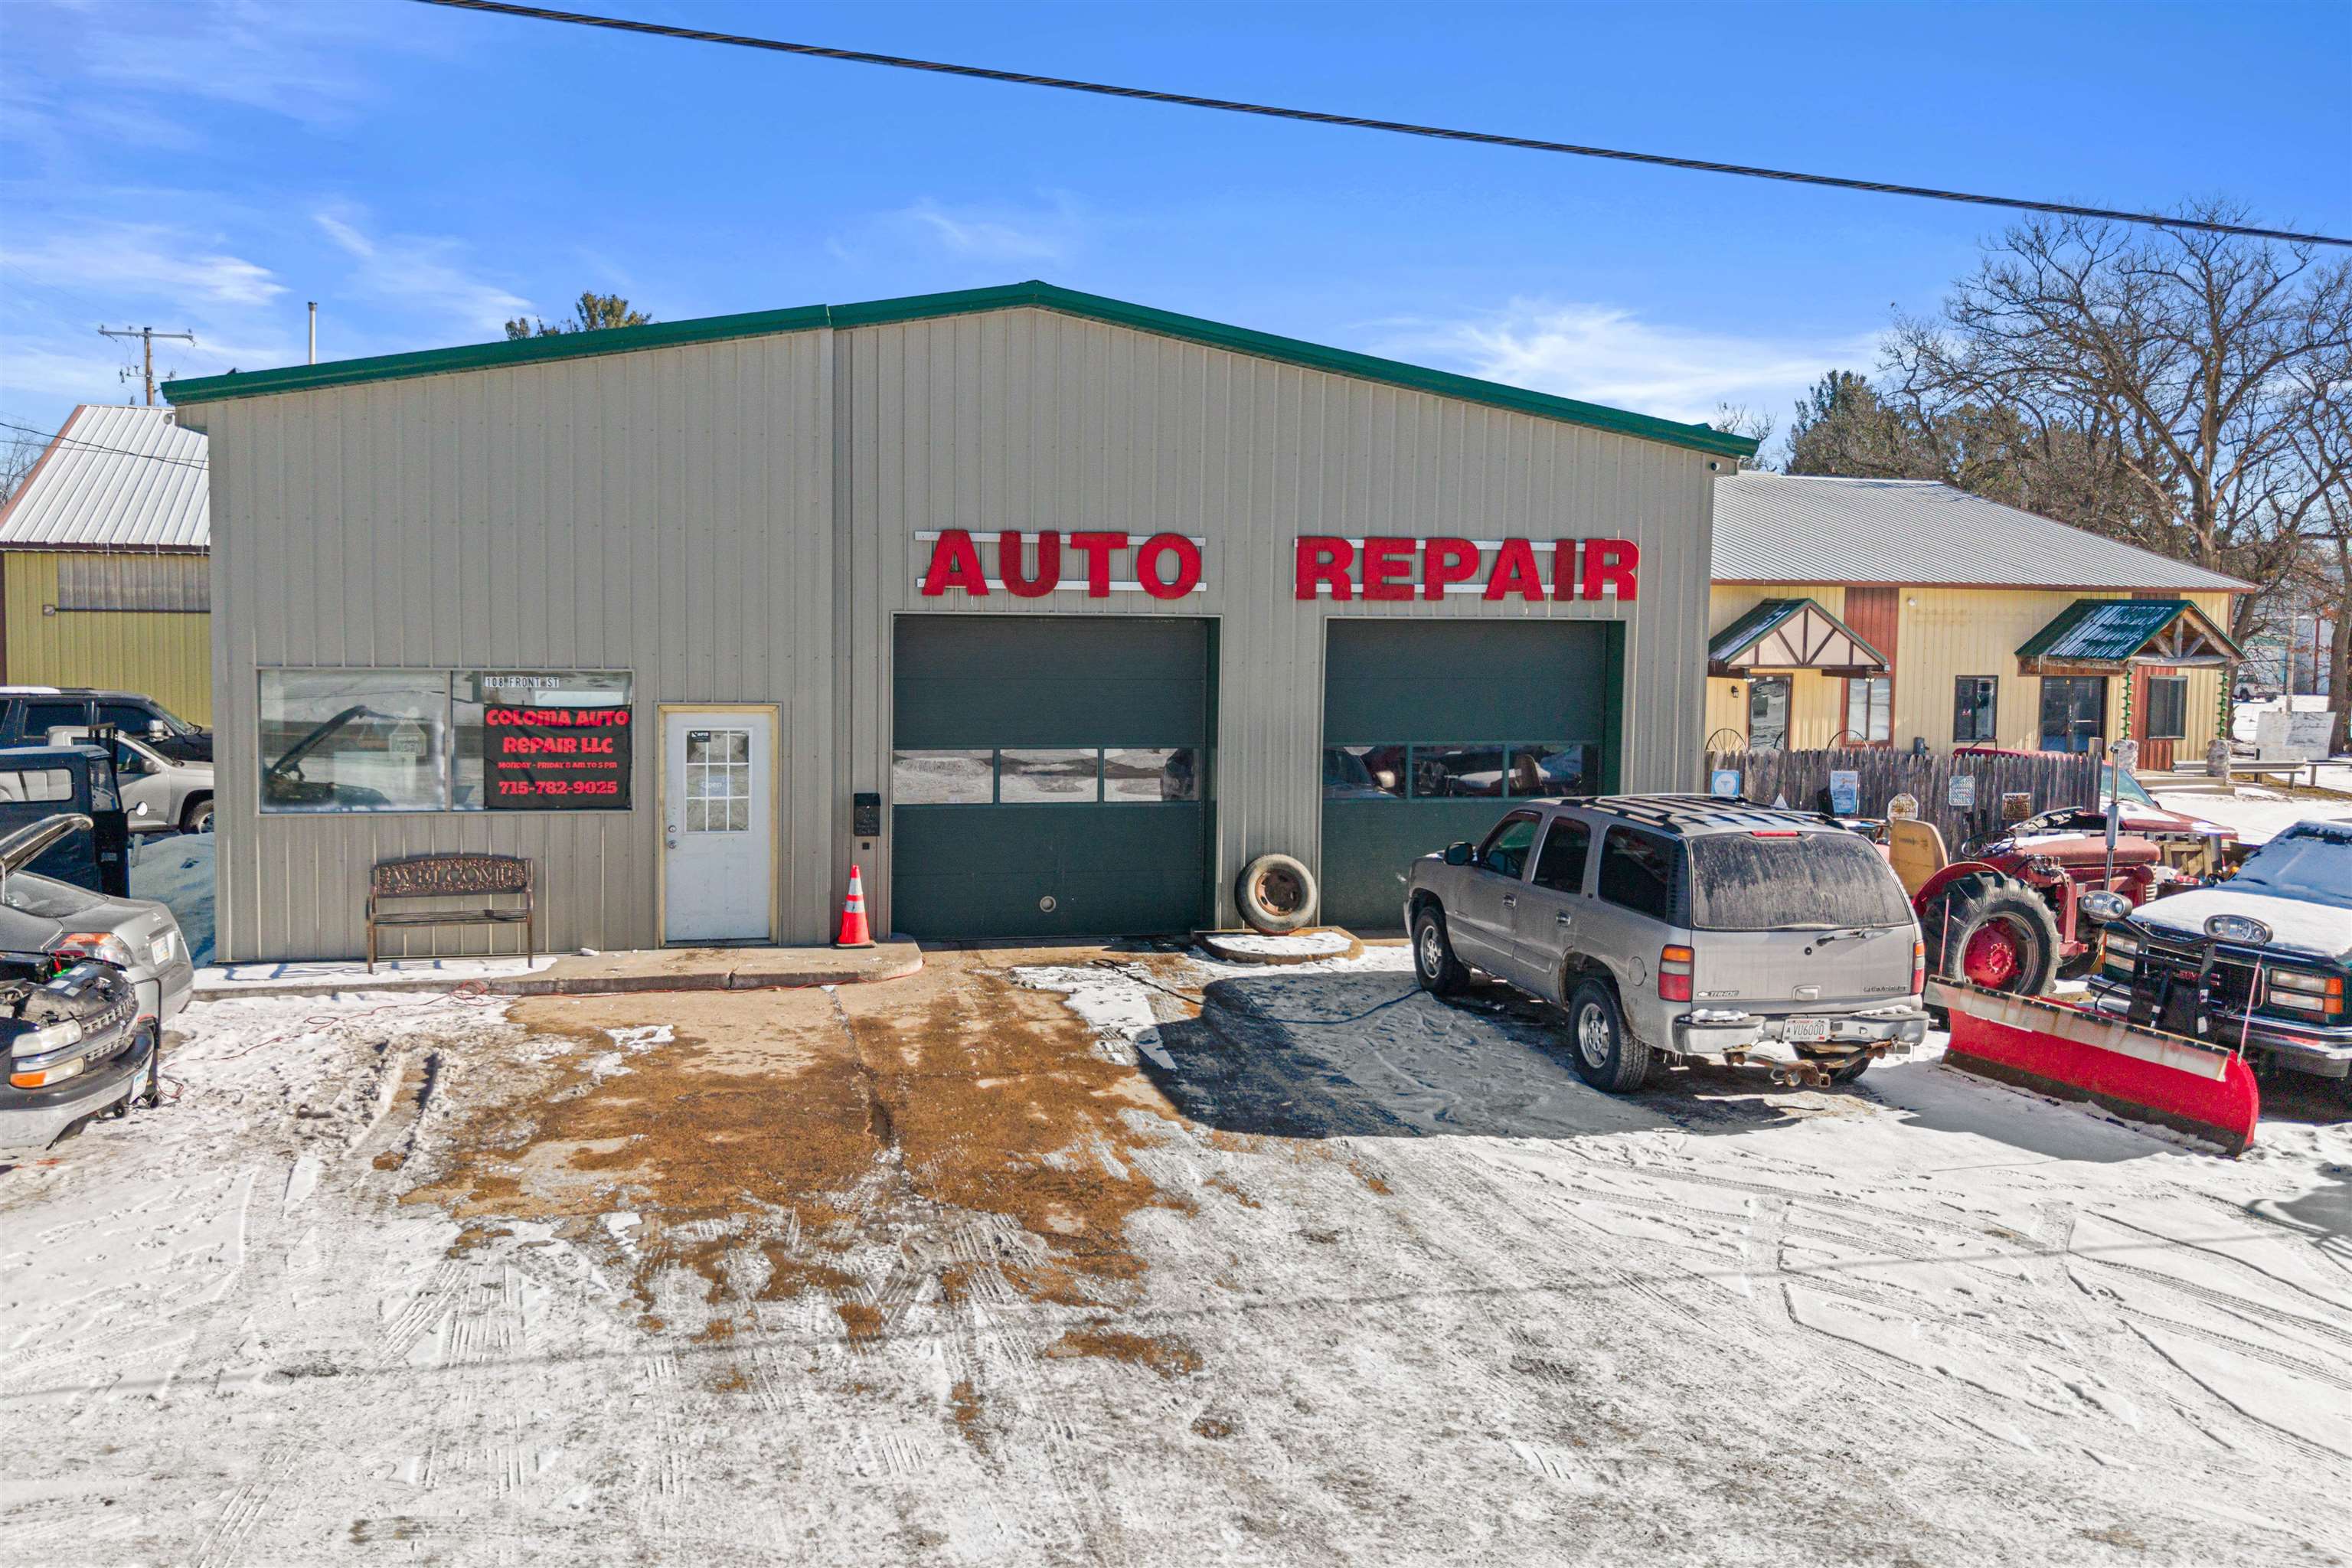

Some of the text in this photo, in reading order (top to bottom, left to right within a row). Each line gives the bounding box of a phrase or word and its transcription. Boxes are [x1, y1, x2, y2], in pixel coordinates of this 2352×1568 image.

[922, 529, 1640, 601] AUTO REPAIR
[487, 677, 559, 688] 108 FRONT ST
[485, 709, 629, 727] COLOMA AUTO
[581, 737, 613, 753] LLC
[498, 781, 618, 795] 715-782-9025
